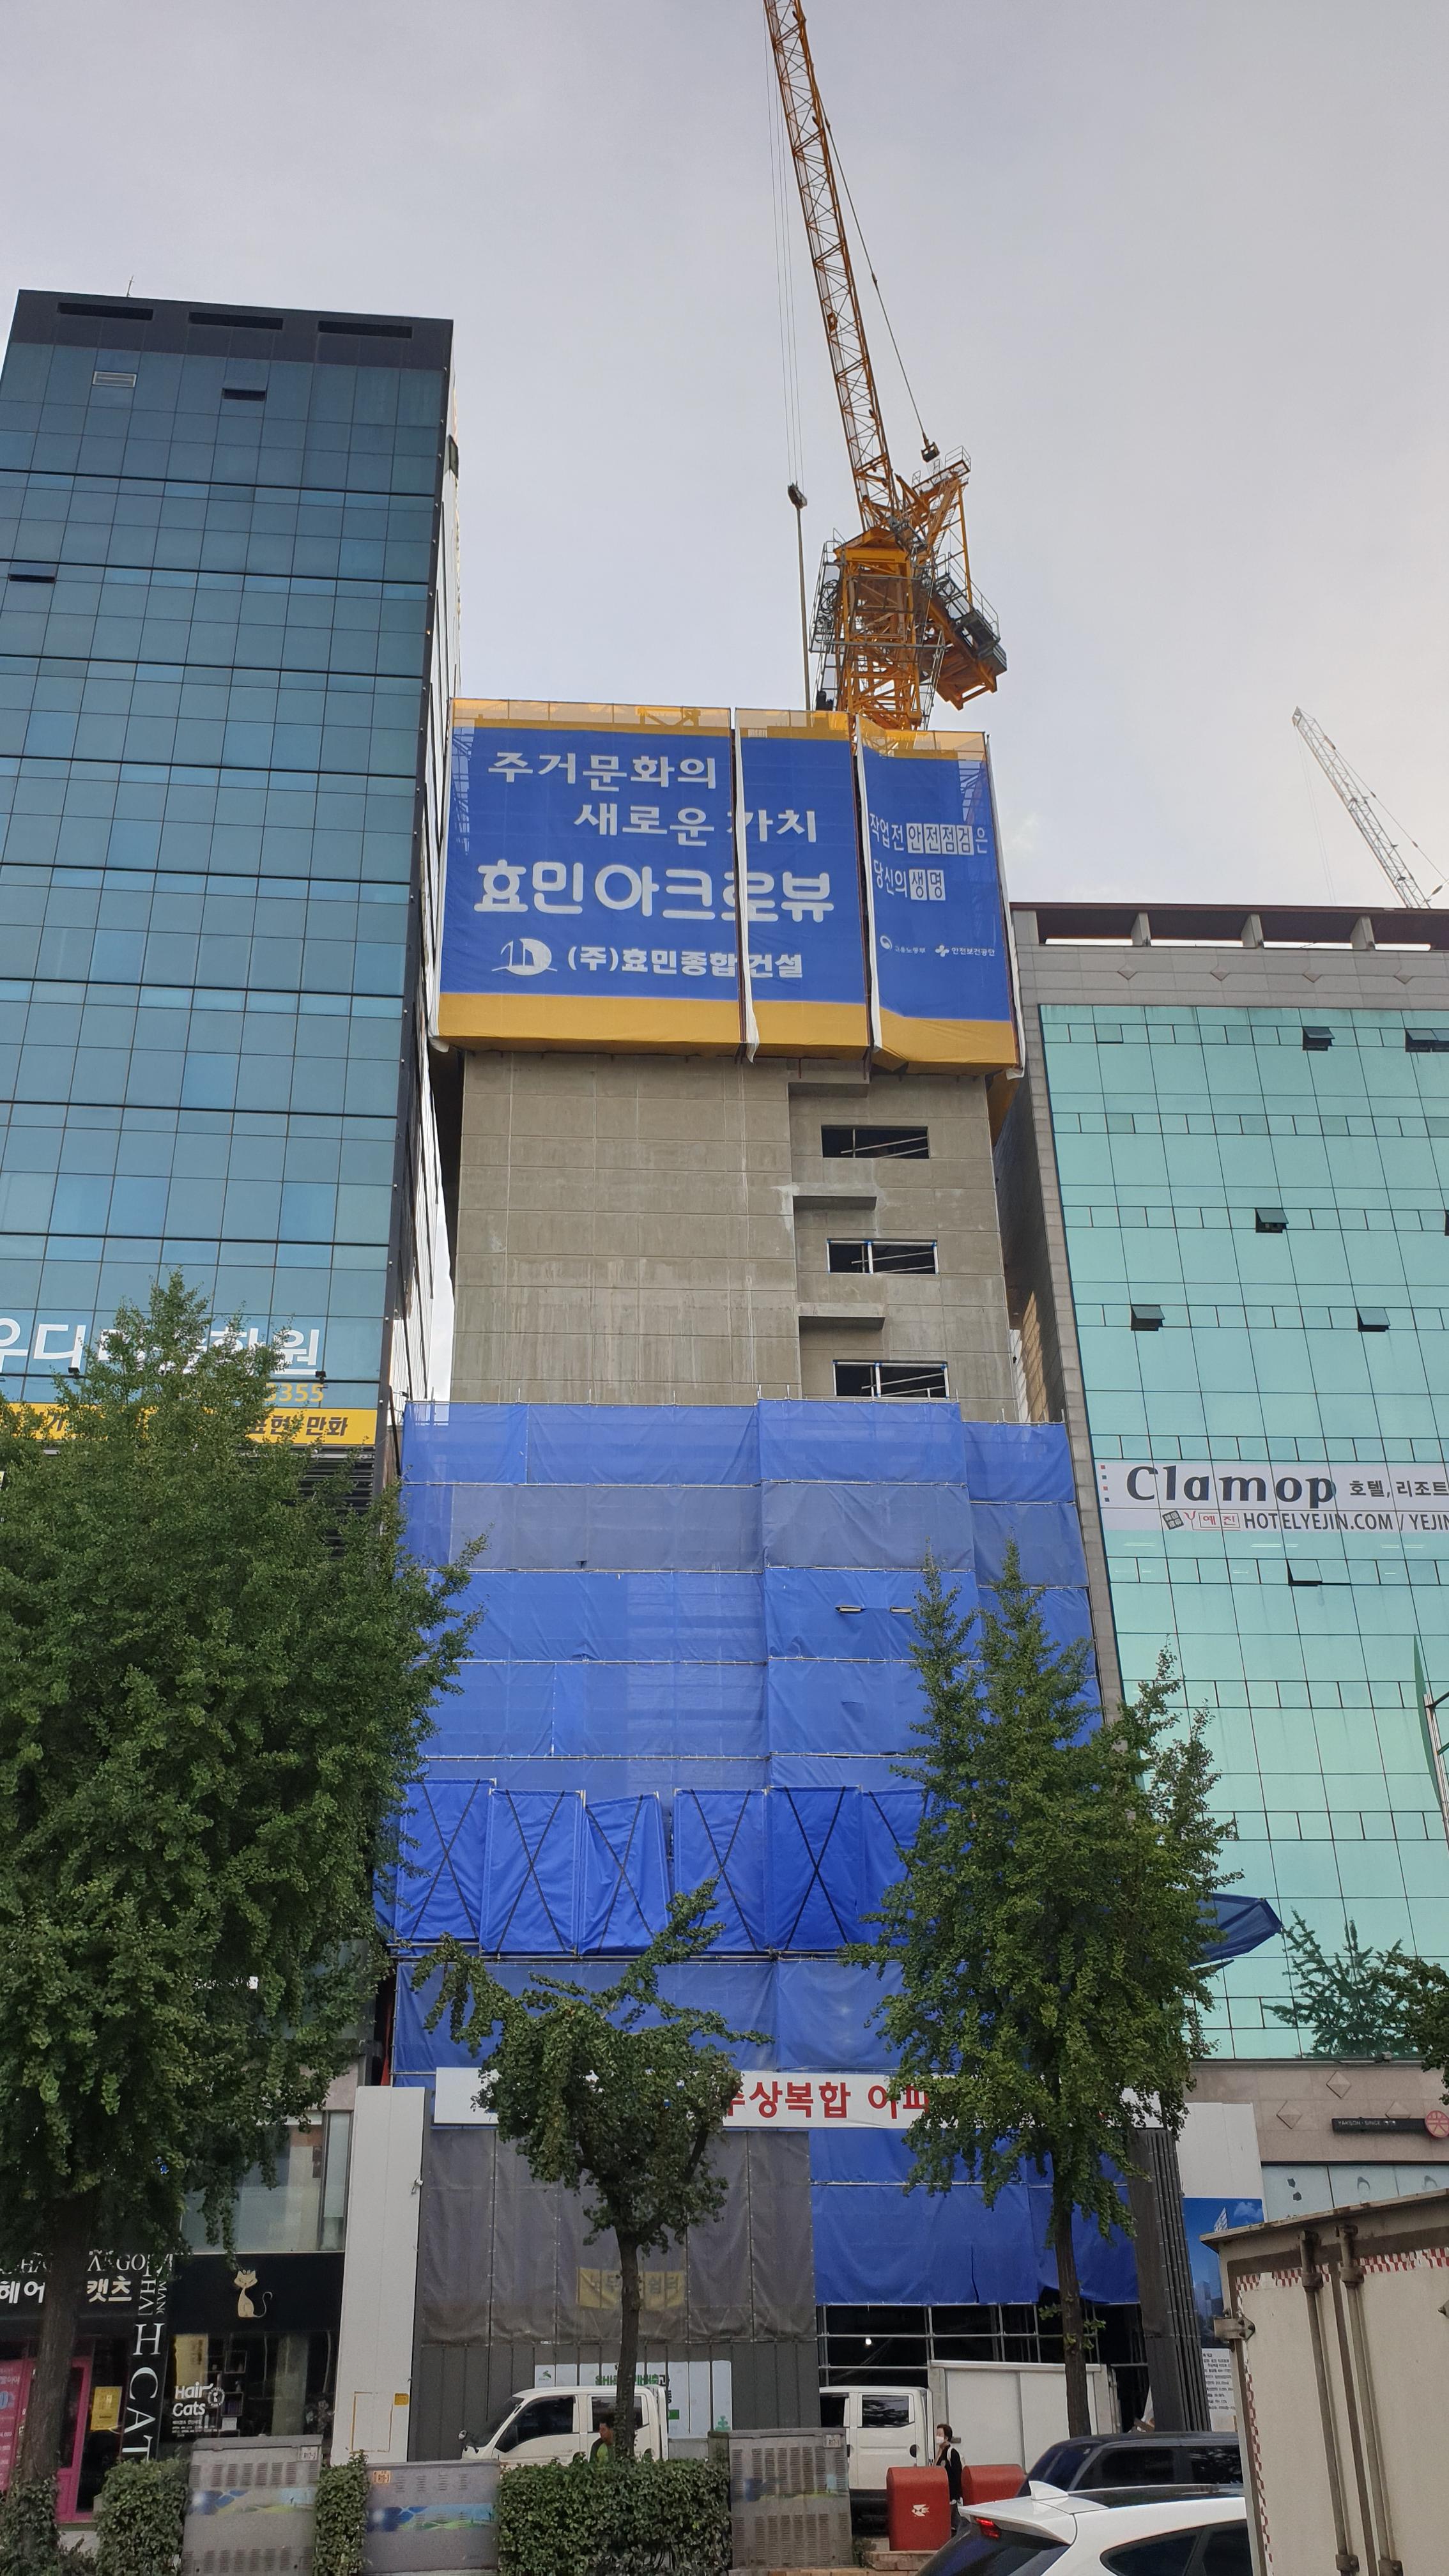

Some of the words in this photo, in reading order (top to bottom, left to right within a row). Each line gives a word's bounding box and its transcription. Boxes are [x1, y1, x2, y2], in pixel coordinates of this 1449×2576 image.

[488, 751, 716, 792] 주거문화의
[574, 802, 715, 847] 새로운
[568, 946, 802, 978] (주)효민종합건설
[951, 947, 995, 956] 안전보건공단
[1126, 1465, 1337, 1509] Clamop
[1349, 1480, 1390, 1498] 호텔,
[1243, 1512, 1393, 1531] HOTELYEJIN.COM
[86, 2275, 132, 2303] 캣츠
[174, 2381, 214, 2400] Hair
[172, 2401, 206, 2417] Cats
